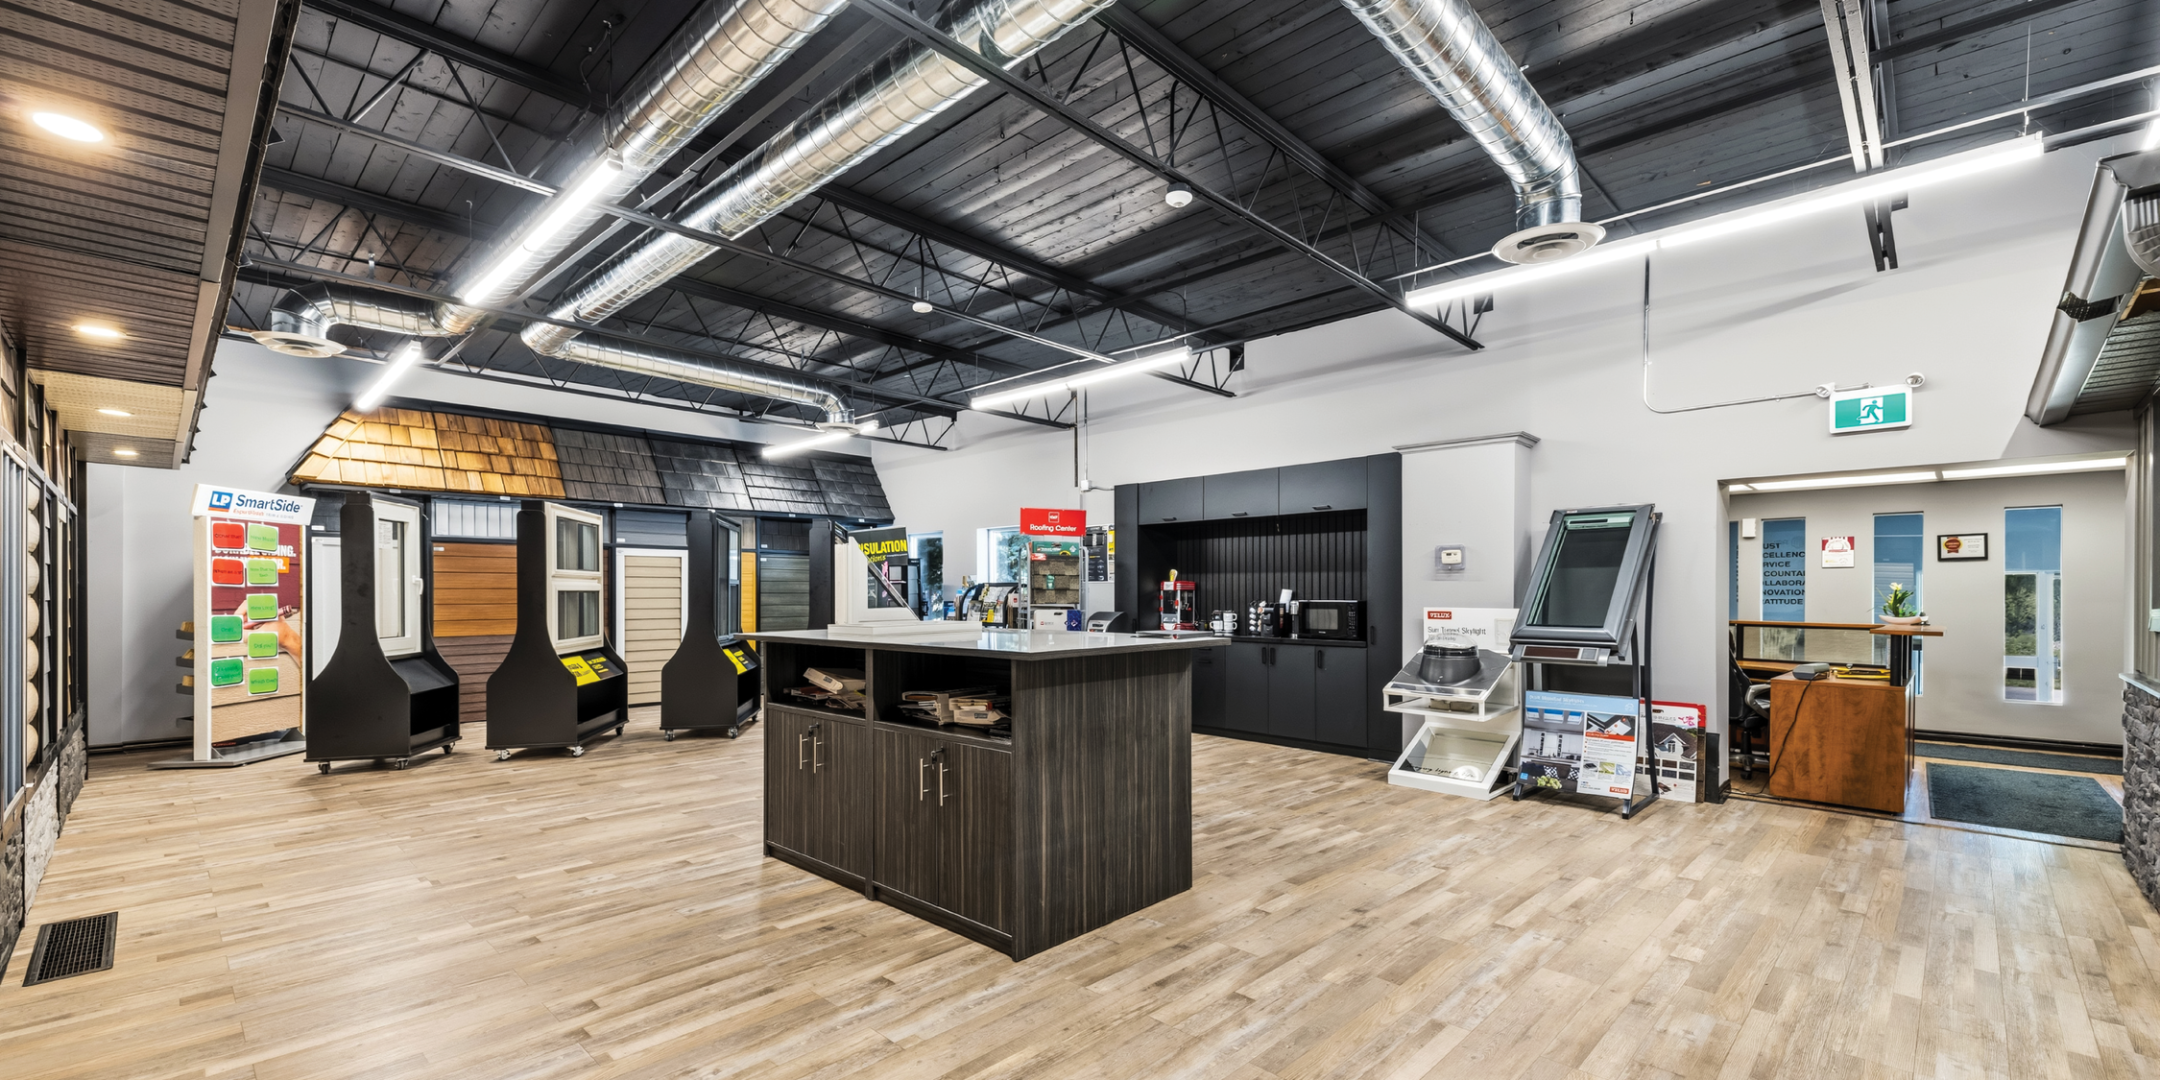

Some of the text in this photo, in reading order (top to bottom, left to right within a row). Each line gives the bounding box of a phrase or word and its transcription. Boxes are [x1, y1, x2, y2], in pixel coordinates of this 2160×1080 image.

[235, 494, 301, 513] SmartSide
[1030, 524, 1054, 532] Roofing
[858, 540, 908, 556] NSULATION
